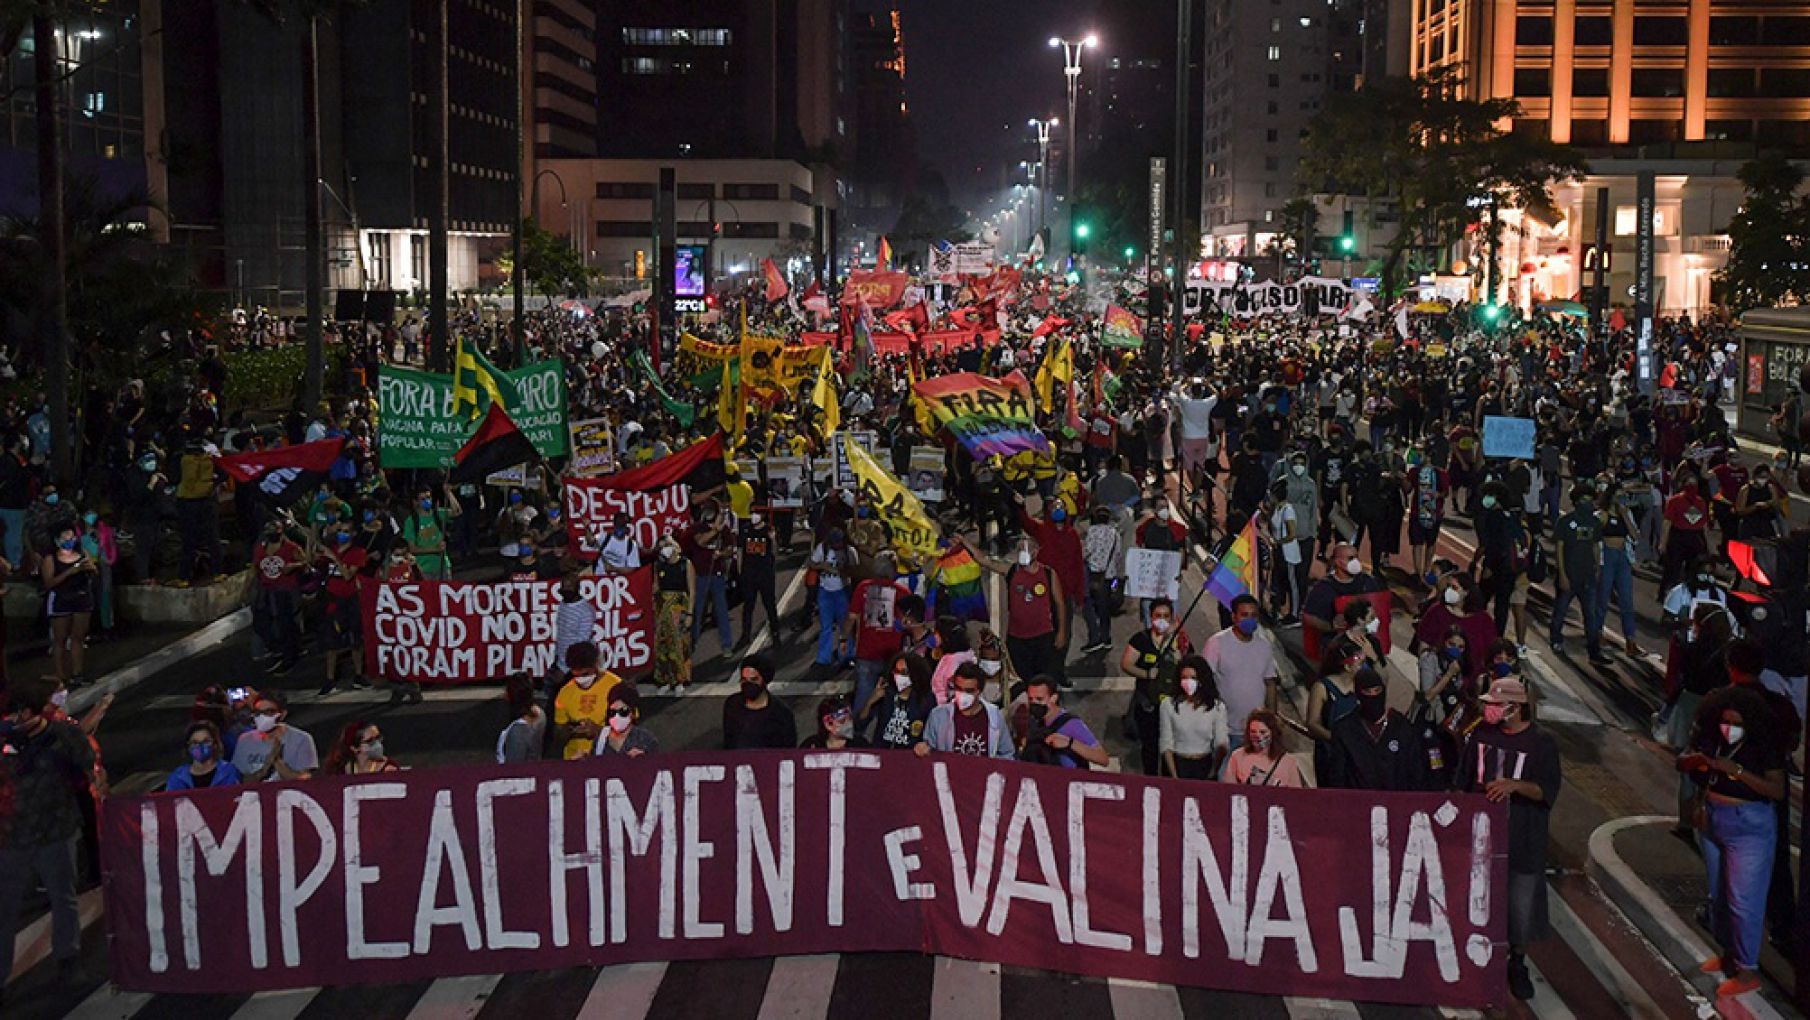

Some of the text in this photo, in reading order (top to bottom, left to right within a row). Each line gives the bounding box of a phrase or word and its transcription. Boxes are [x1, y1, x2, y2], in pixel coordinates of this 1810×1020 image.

[1150, 183, 1160, 218] Gomide
[1640, 197, 1650, 237] Azevedo
[1640, 239, 1649, 268] Rocha
[378, 374, 439, 418] FORA
[376, 584, 425, 617] AS
[579, 575, 636, 611] POR
[374, 613, 467, 648] COVID
[481, 612, 525, 643] NO
[378, 644, 476, 678] FORAM
[140, 752, 881, 973] IMPEACHMENT
[933, 761, 1318, 973] VACINA
